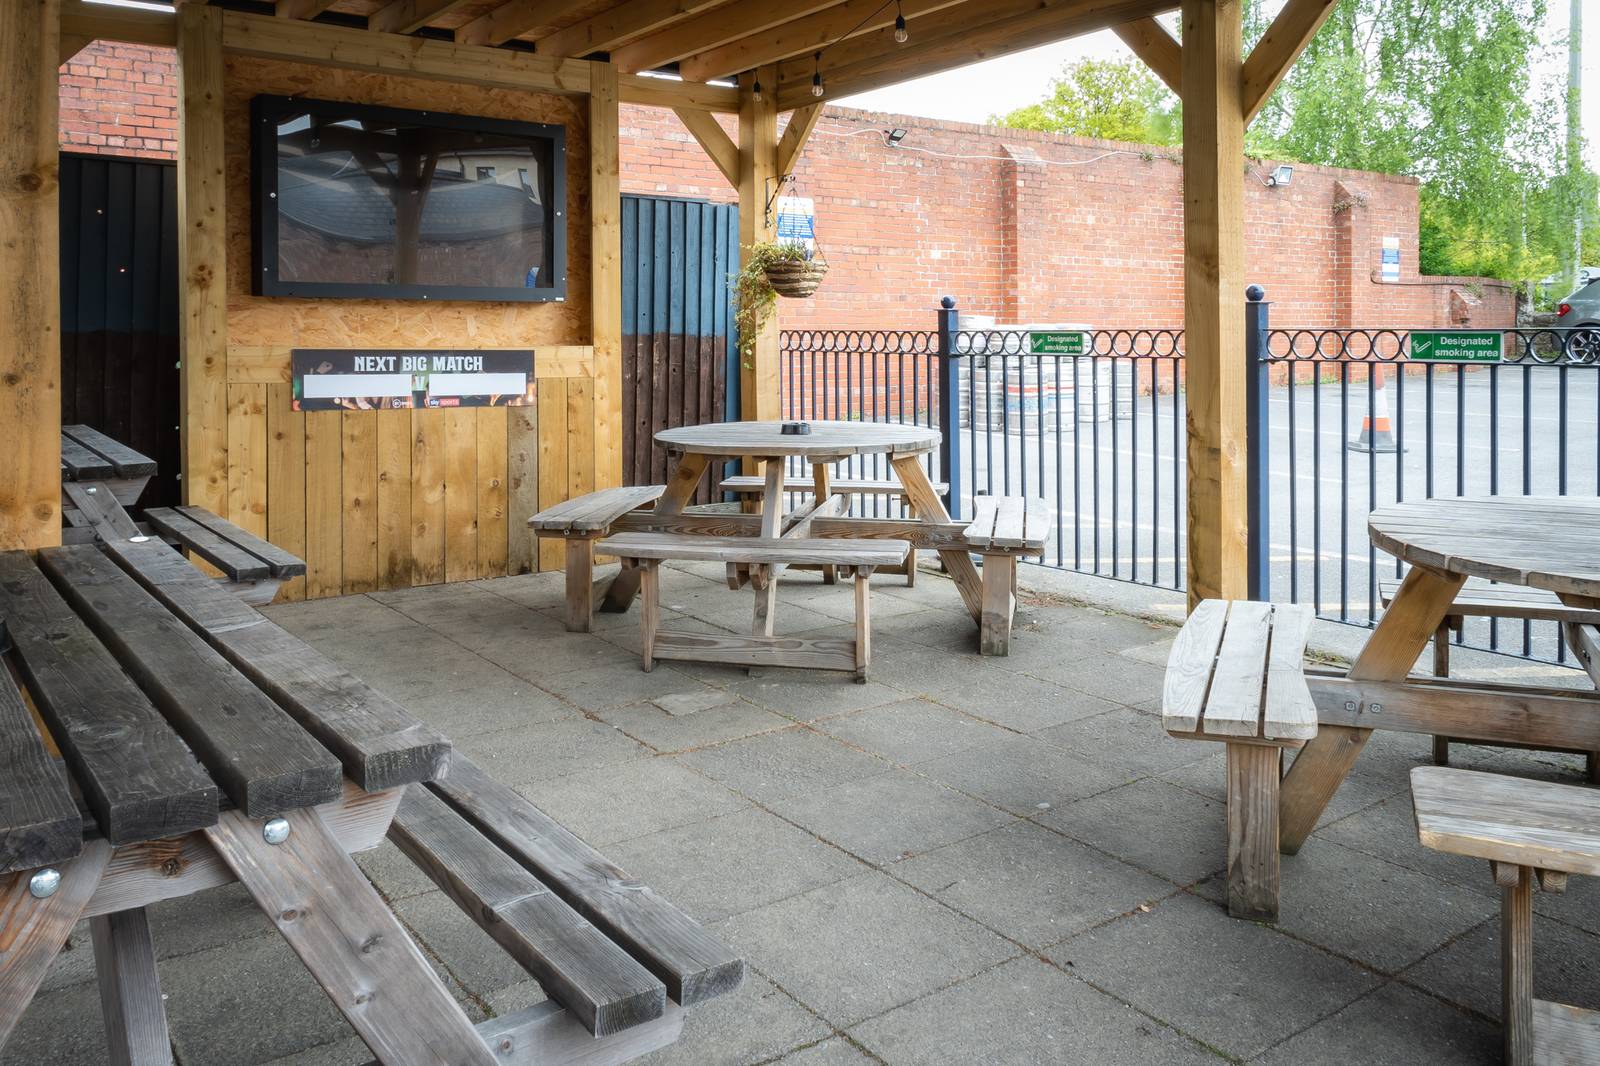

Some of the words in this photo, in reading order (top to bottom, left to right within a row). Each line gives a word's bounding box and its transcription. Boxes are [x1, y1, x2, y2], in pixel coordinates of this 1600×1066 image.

[1440, 336, 1492, 346] Designated
[1434, 349, 1475, 358] smoking
[354, 356, 396, 371] NEXT
[401, 356, 427, 371] BIG
[432, 356, 483, 371] MATCH
